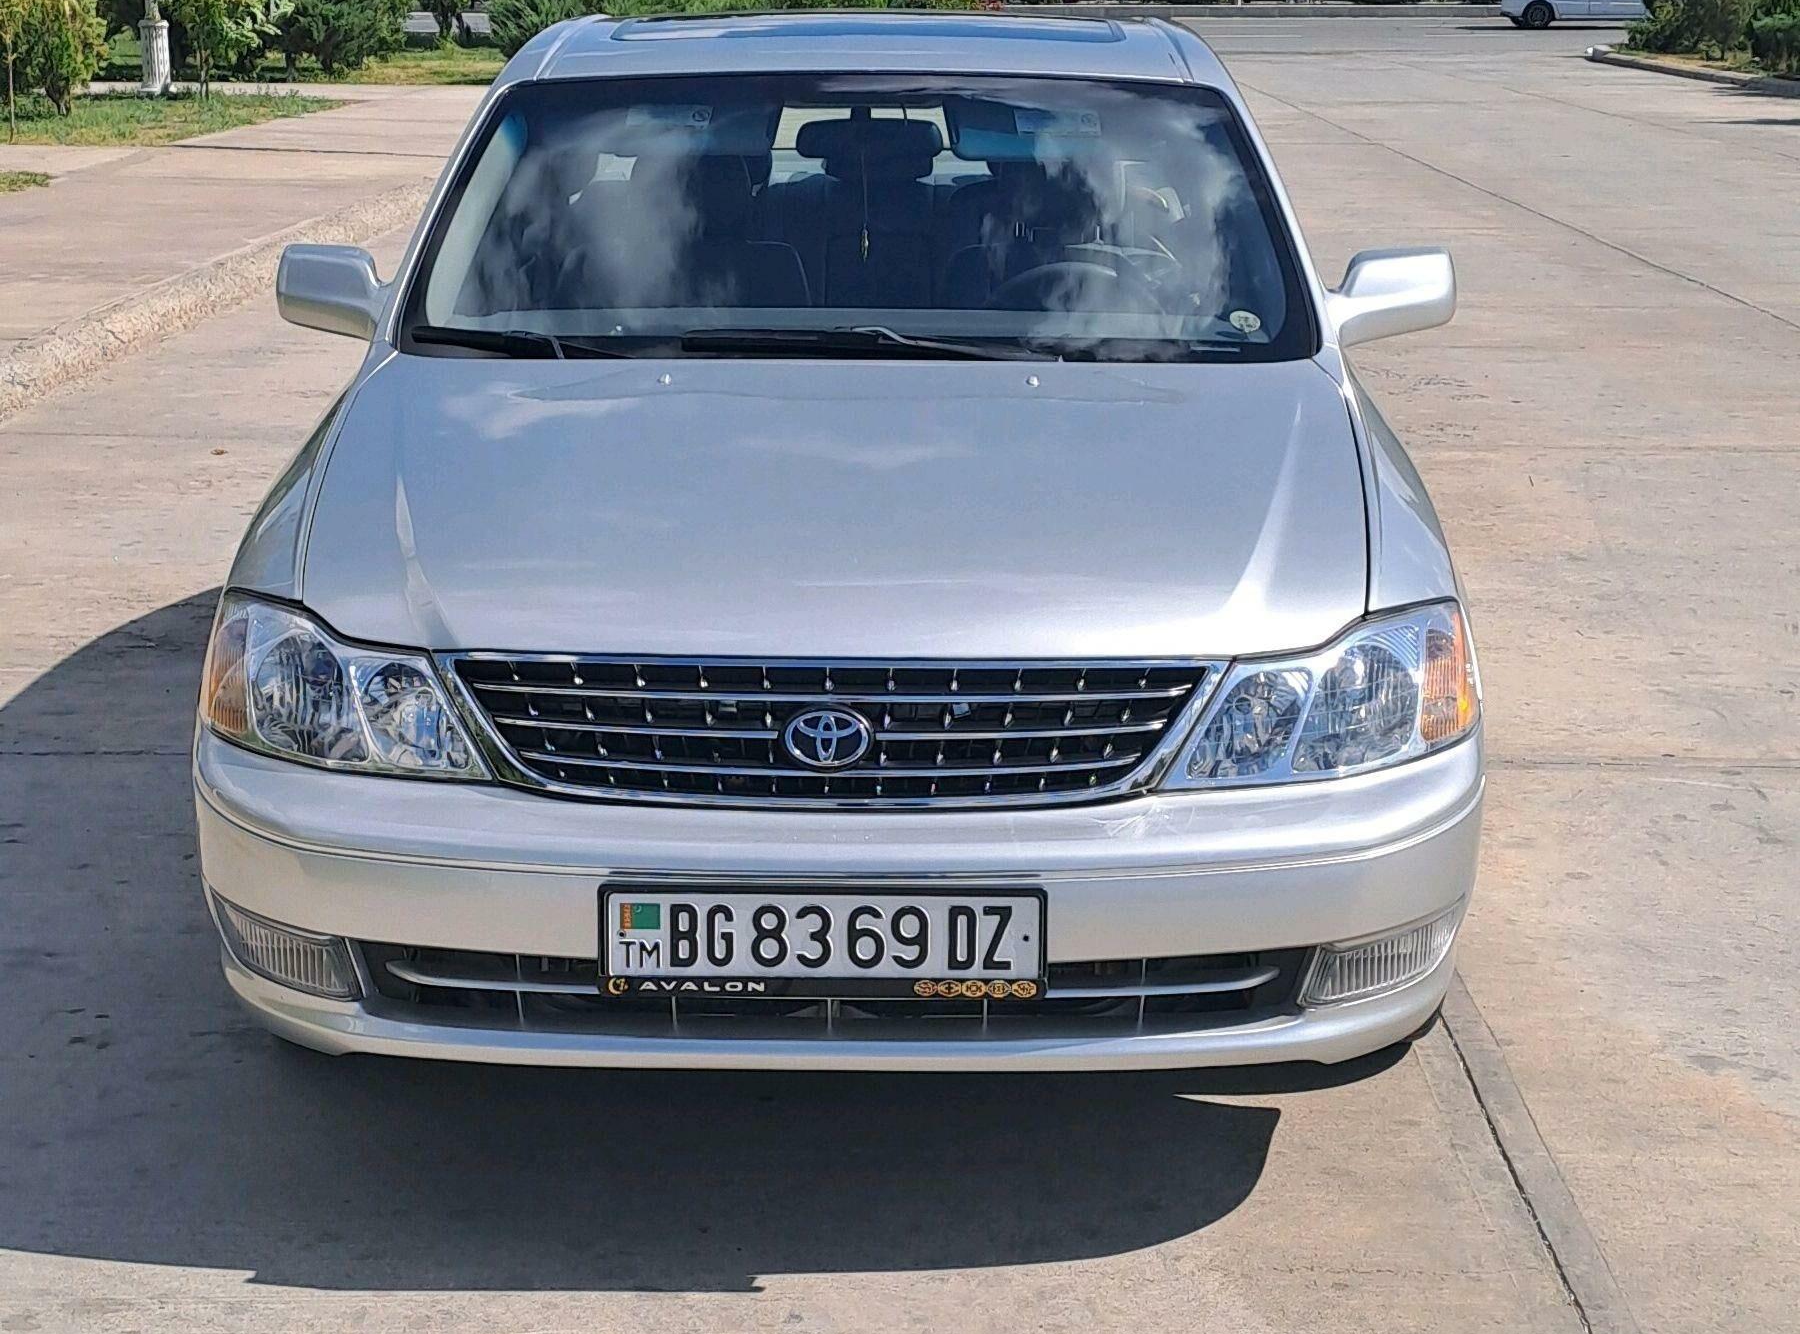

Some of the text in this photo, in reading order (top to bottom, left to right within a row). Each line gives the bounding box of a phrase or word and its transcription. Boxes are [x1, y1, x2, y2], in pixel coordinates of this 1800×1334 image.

[669, 902, 735, 969] BG
[946, 905, 1014, 971] DZ
[618, 940, 662, 969] TM
[638, 980, 766, 992] AVALON
